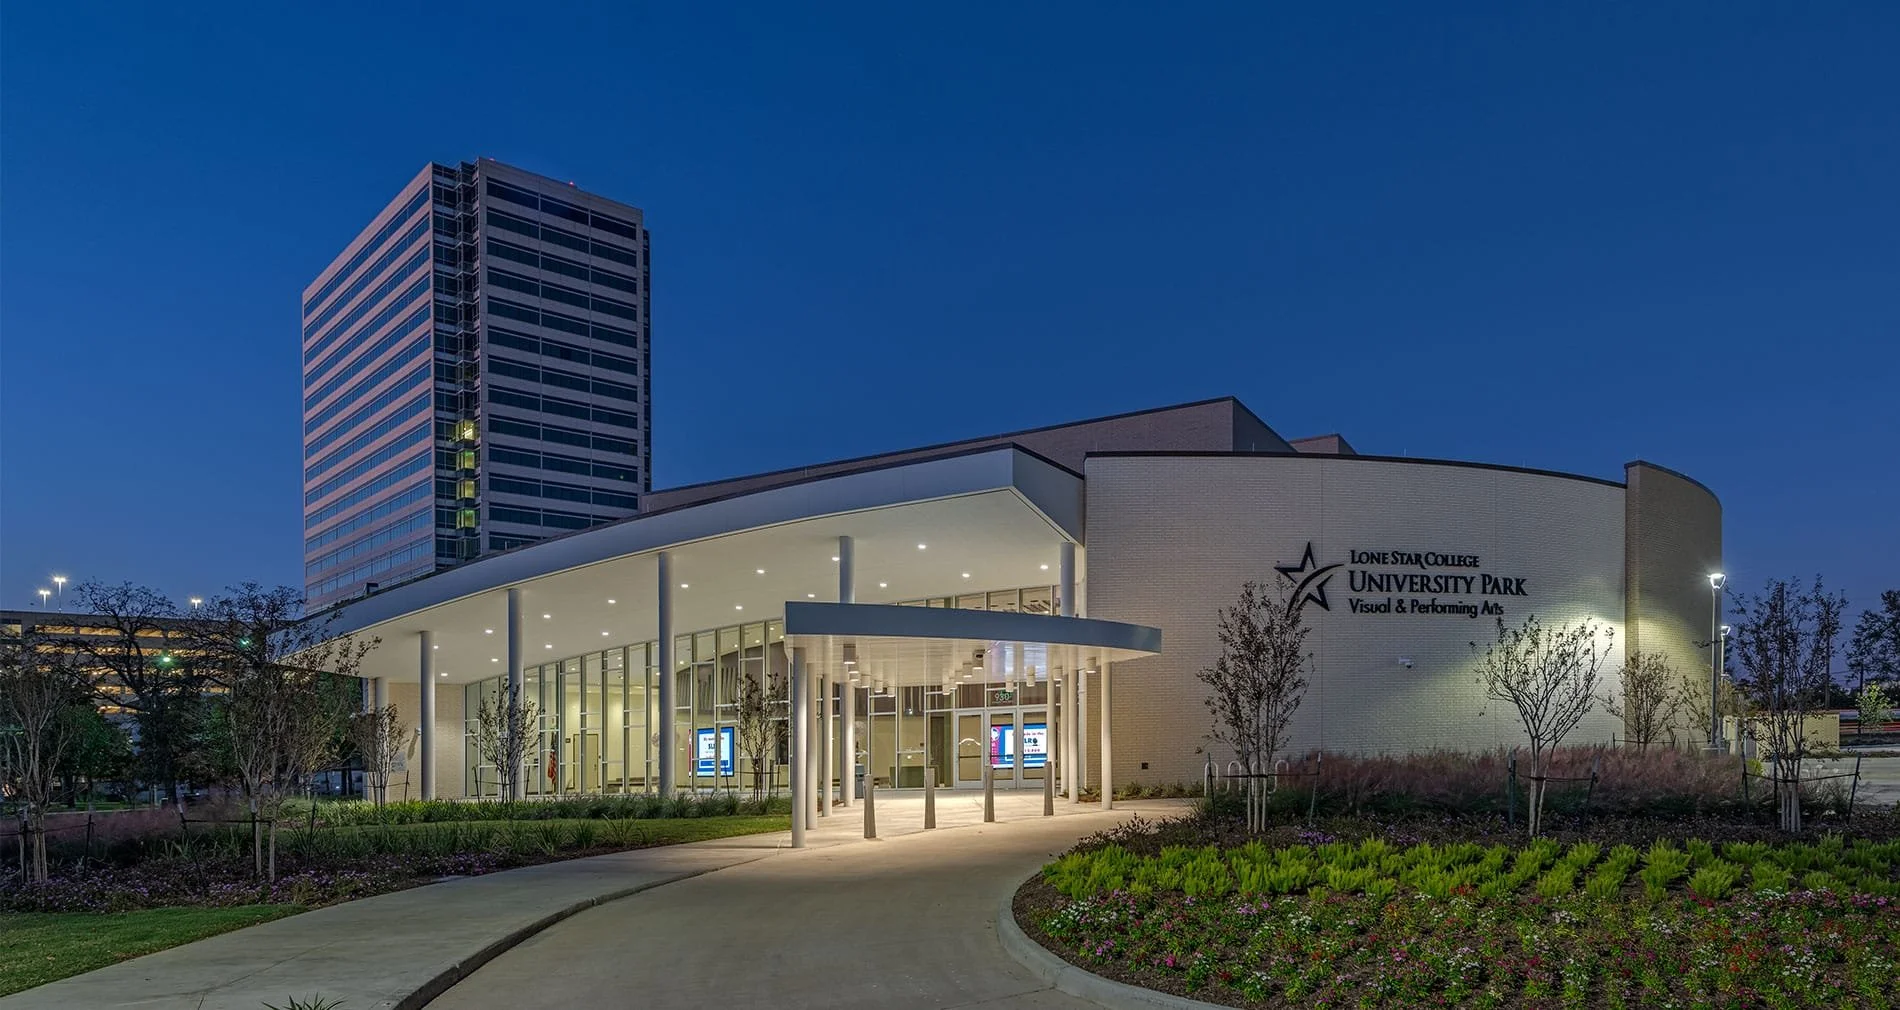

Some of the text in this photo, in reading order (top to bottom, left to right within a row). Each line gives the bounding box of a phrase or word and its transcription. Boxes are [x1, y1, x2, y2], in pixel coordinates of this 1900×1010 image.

[1350, 550, 1480, 570] LONE STAR COLLEGE
[1348, 570, 1528, 596] UNIVERSITY PARK
[1349, 598, 1504, 619] Visual & Performing Arts
